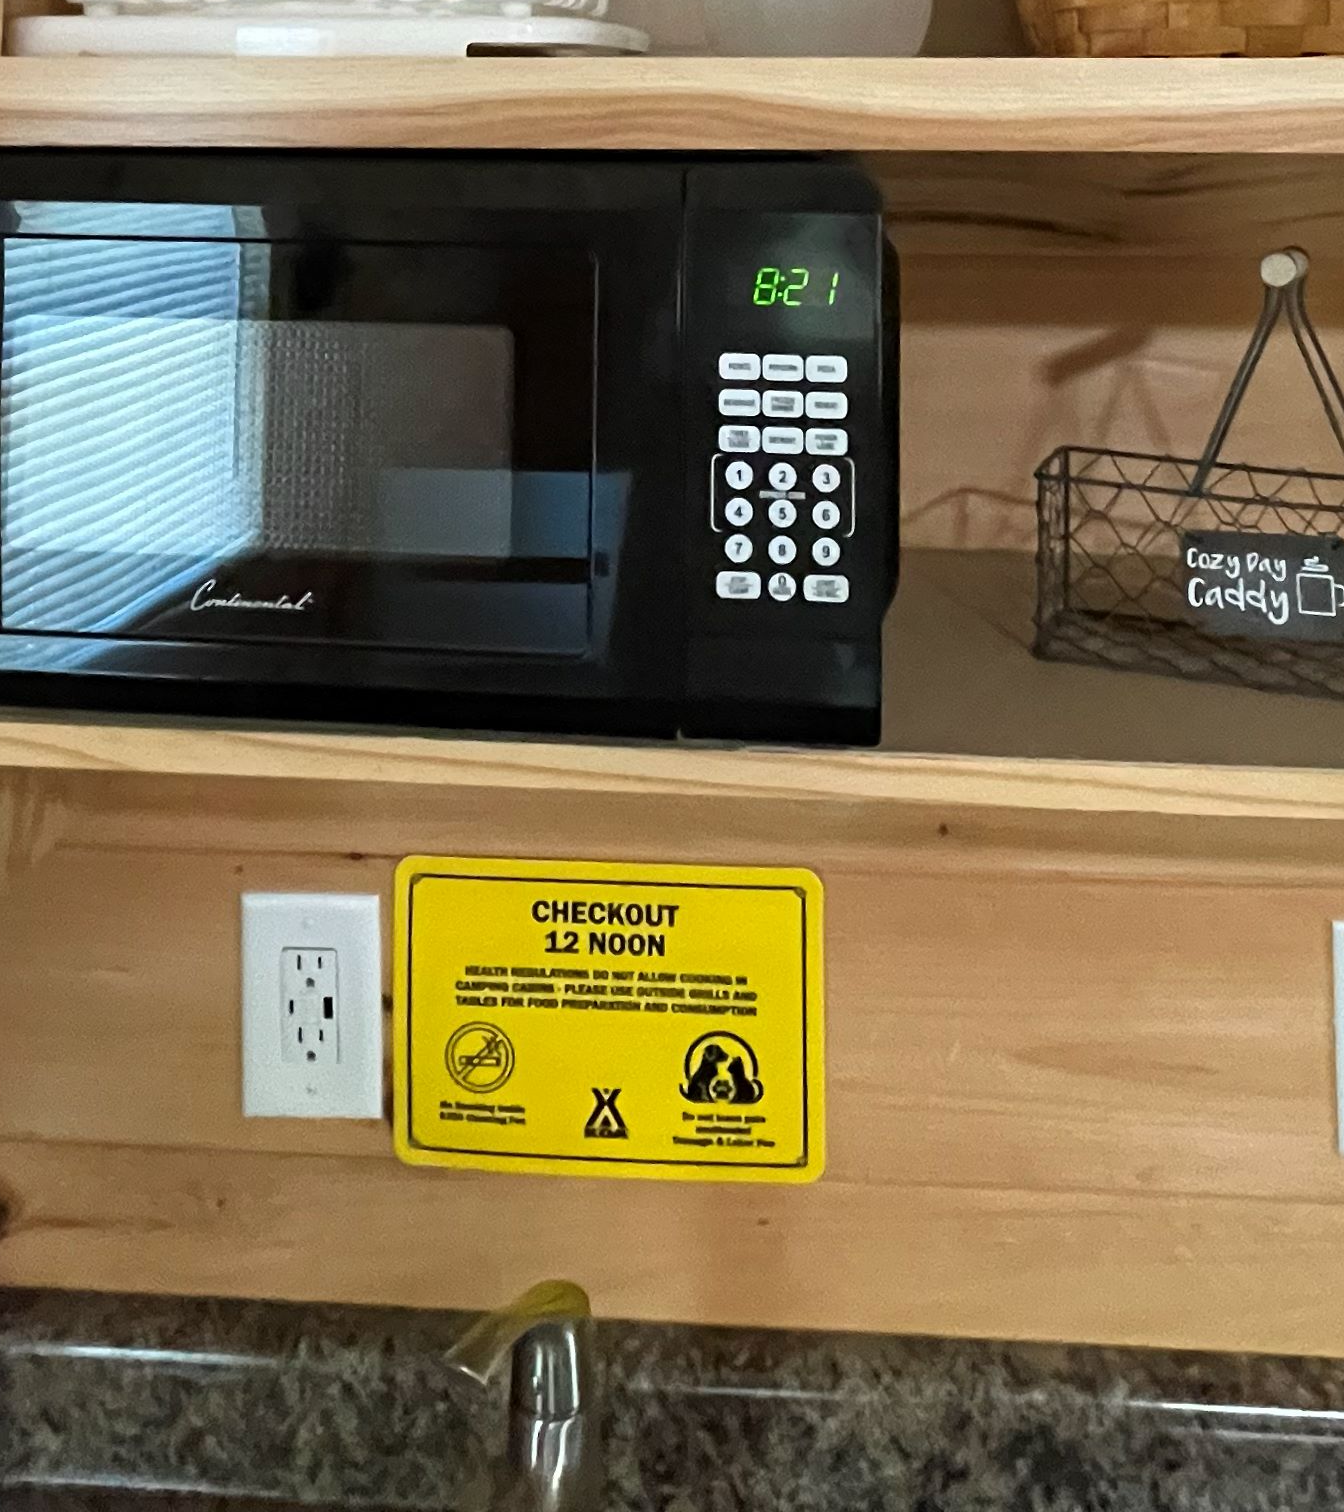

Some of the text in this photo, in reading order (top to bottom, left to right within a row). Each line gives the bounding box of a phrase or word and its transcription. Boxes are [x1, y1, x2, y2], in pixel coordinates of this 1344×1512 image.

[753, 267, 839, 305] 8:21
[736, 469, 742, 482] 1
[778, 470, 787, 484] 2
[822, 471, 831, 485] 3
[734, 506, 743, 518] 4
[778, 507, 787, 520] 5
[822, 508, 831, 522] 6
[734, 542, 743, 555] 7
[778, 544, 787, 557] 8
[822, 545, 831, 559] 9
[1186, 547, 1287, 582] Cozy Day
[1187, 577, 1290, 625] Caddy
[531, 899, 680, 927] CHECKOUT
[544, 930, 665, 957] 12 NOON
